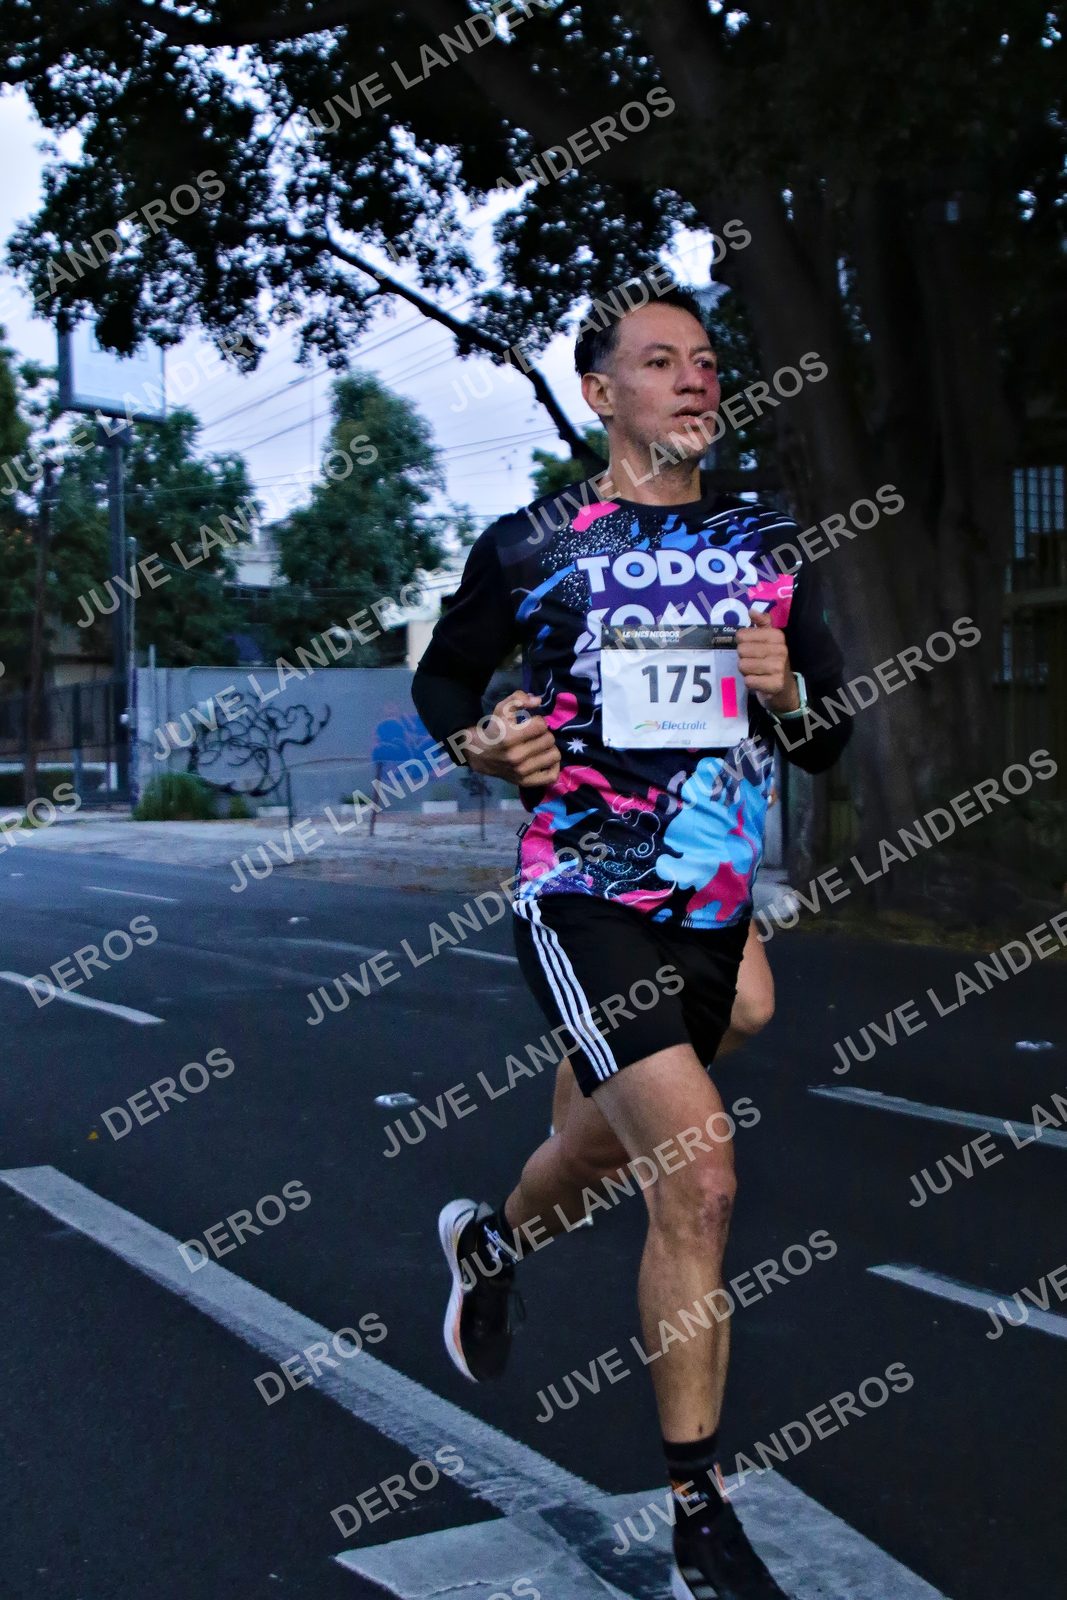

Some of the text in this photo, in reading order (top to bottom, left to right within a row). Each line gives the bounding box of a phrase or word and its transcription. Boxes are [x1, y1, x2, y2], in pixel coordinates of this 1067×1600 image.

[577, 548, 758, 593] TODOS
[574, 599, 770, 655] SOMO
[641, 664, 712, 703] 175
[661, 721, 707, 731] Electrolit
